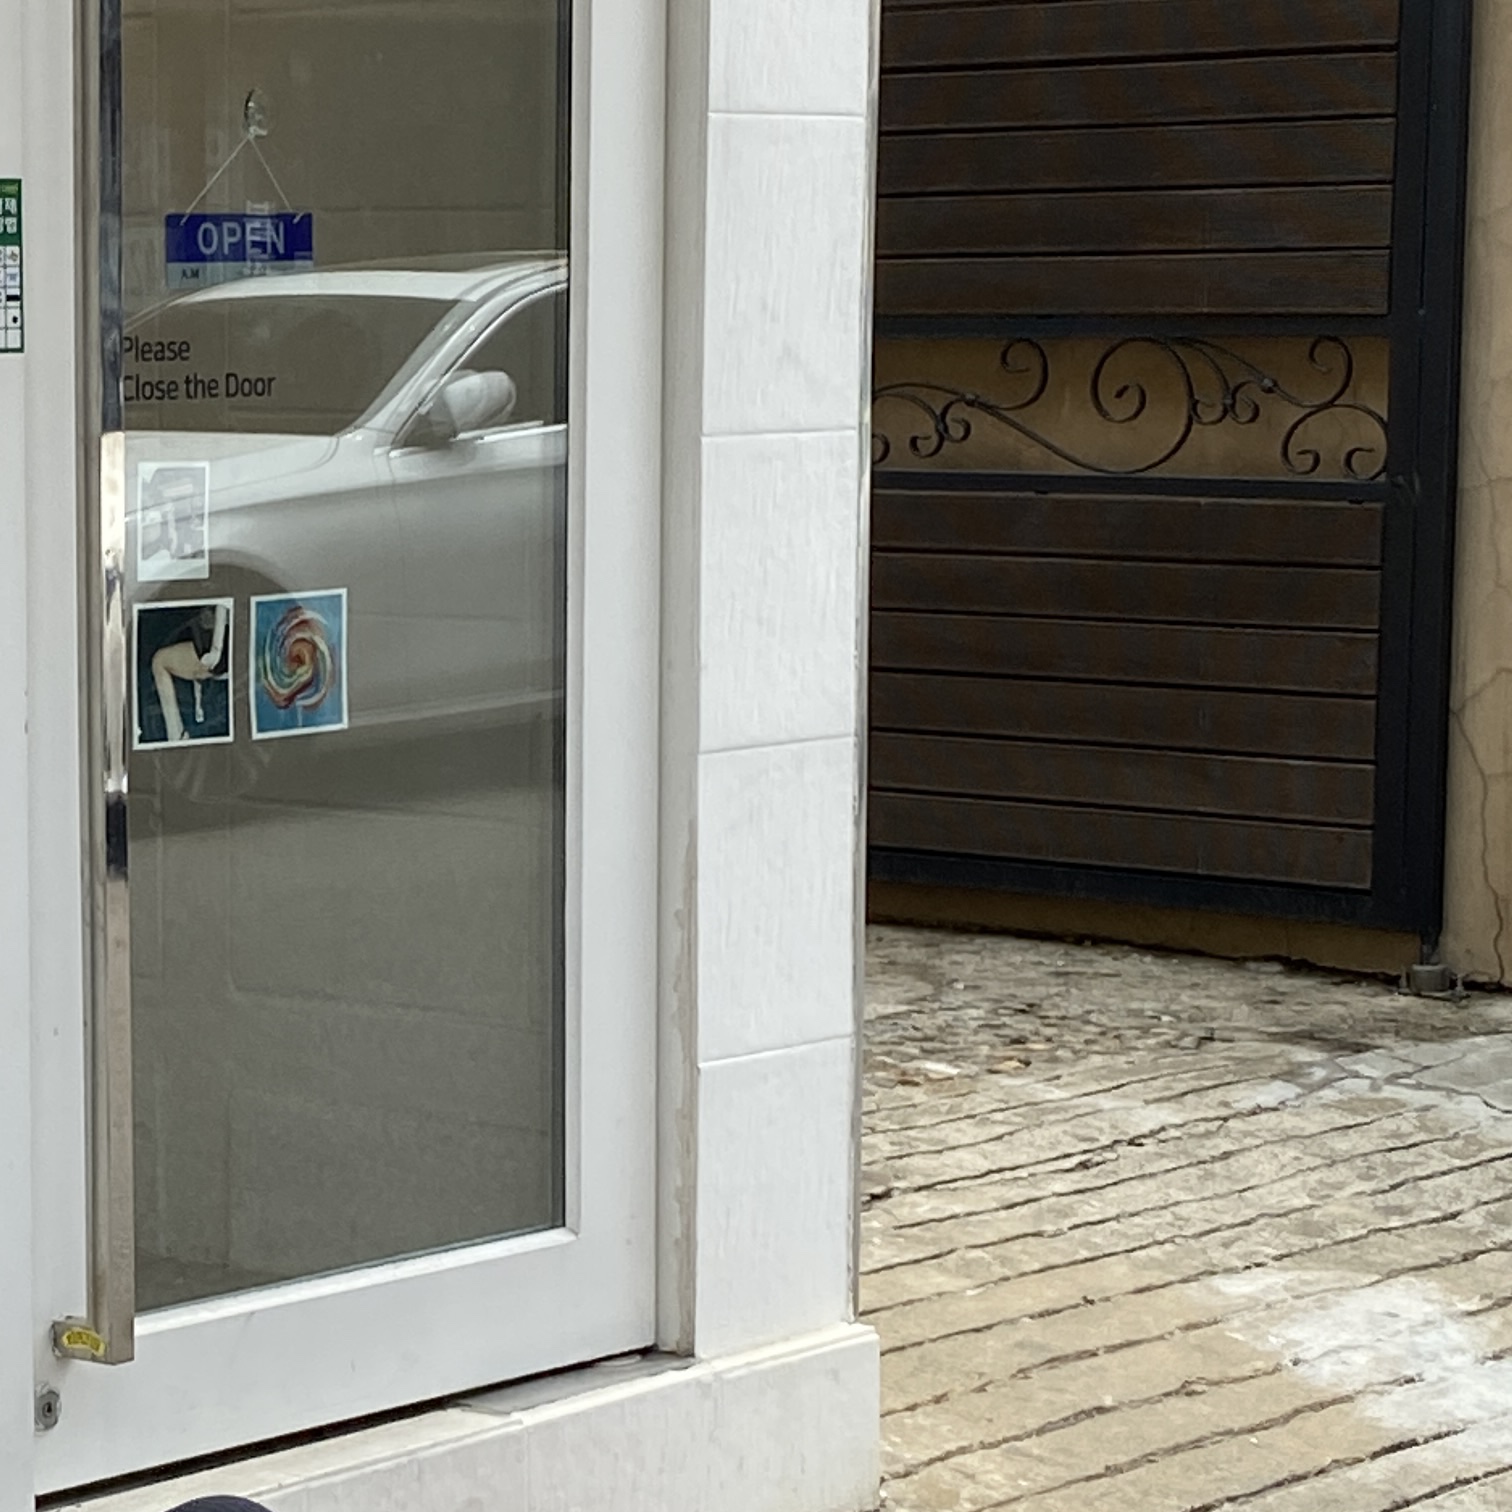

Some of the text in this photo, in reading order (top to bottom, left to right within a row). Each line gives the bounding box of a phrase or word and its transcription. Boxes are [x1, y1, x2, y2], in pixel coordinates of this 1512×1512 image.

[196, 221, 286, 256] OPEN
[121, 336, 191, 363] Please
[121, 373, 276, 402] Close the Door
